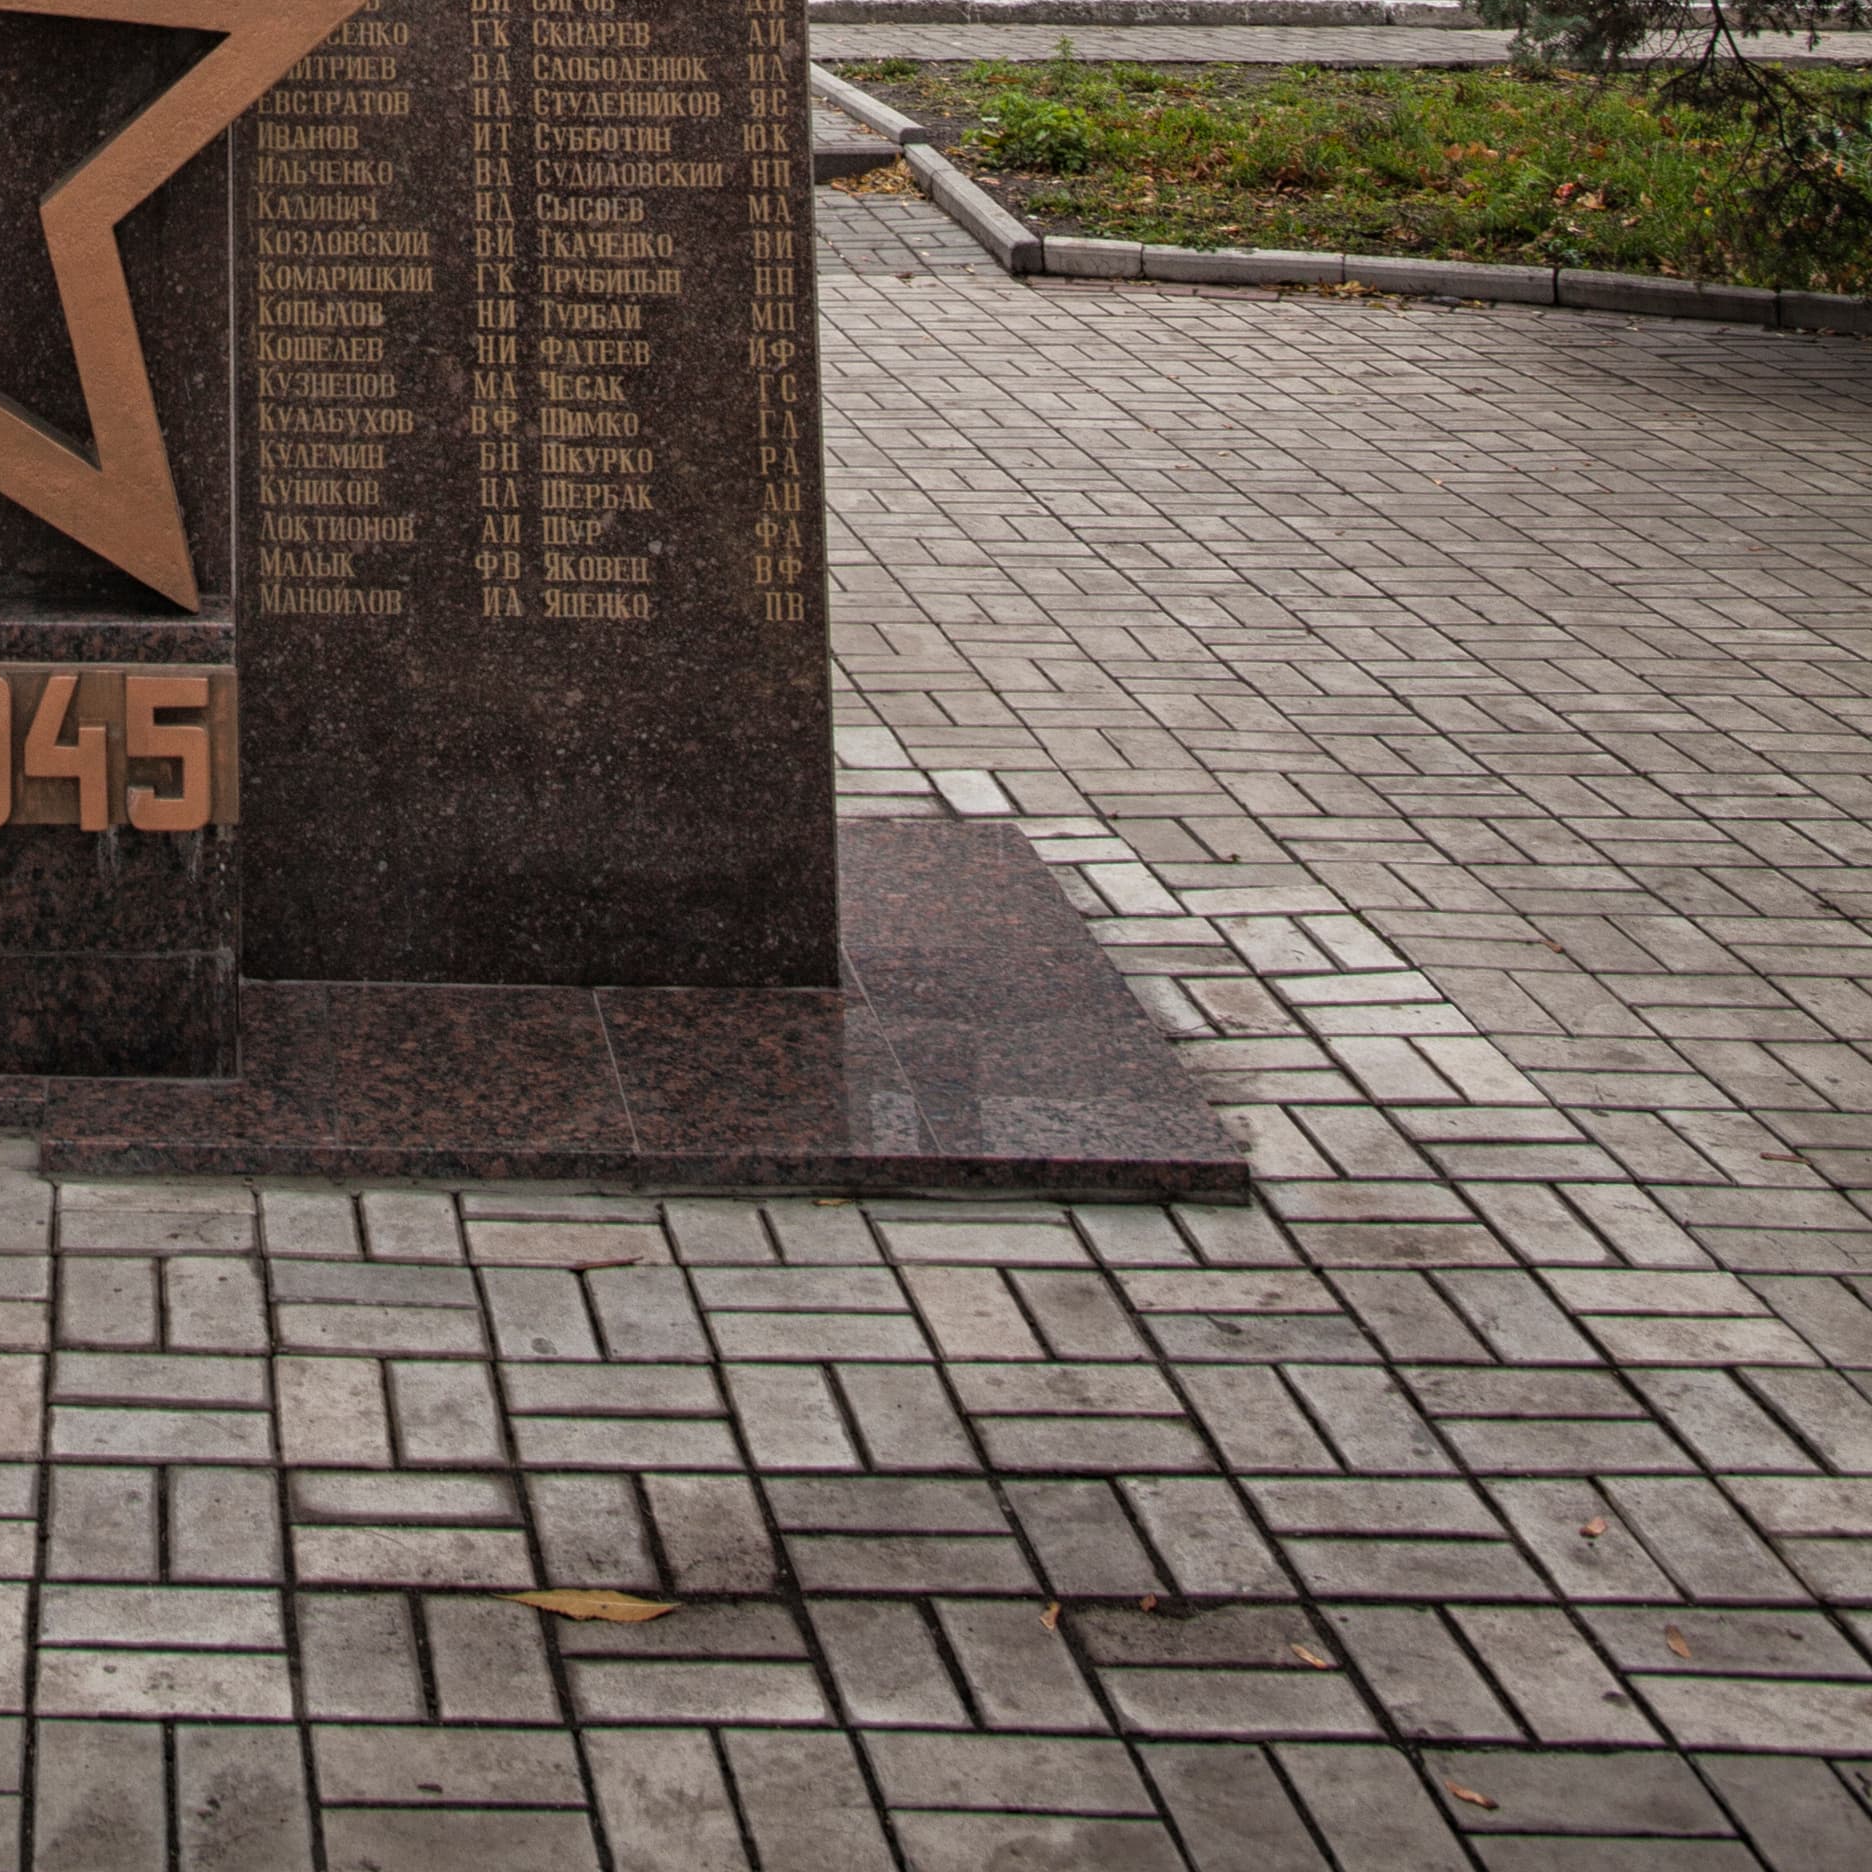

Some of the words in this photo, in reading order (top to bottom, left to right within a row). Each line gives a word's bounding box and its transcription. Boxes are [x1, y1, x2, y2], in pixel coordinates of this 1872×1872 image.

[533, 18, 651, 48] СКНАРЕВ
[534, 54, 708, 83] СЛОБОДЕНЮК
[534, 88, 721, 118] СТУДЕННИКОВ
[258, 122, 359, 151] ИВАНОВ
[535, 123, 672, 152] СУББОТИН
[258, 156, 393, 185] ИЛЬЧЕНКО
[258, 192, 377, 221] КАЛИНИЧ
[537, 194, 644, 223] СЫСОЕВ
[538, 229, 674, 258] ТКАЧЕНКО
[539, 264, 682, 296] ТРУБИЦЫН
[258, 296, 384, 327] КОПЫЛОВ
[258, 332, 384, 362] КОШЕЛЕВ
[540, 336, 650, 366] ФАТЕЕВ
[258, 368, 397, 402] КУЗНЕЦОВ
[540, 372, 626, 401] ЧЕСАК
[258, 404, 414, 435] КУЛАБУХОВ
[541, 408, 639, 438] ШИМКО
[260, 440, 384, 470] КУЛЕМИН
[542, 444, 654, 474] ШКУРКО
[260, 476, 380, 506] КУНИКОВ
[260, 511, 415, 543] ЛОКТИОНОВ
[260, 547, 356, 578] МАЛЫК
[544, 552, 652, 584] ЯКОВЕЦ
[544, 588, 651, 621] ЯЦЕНКО
